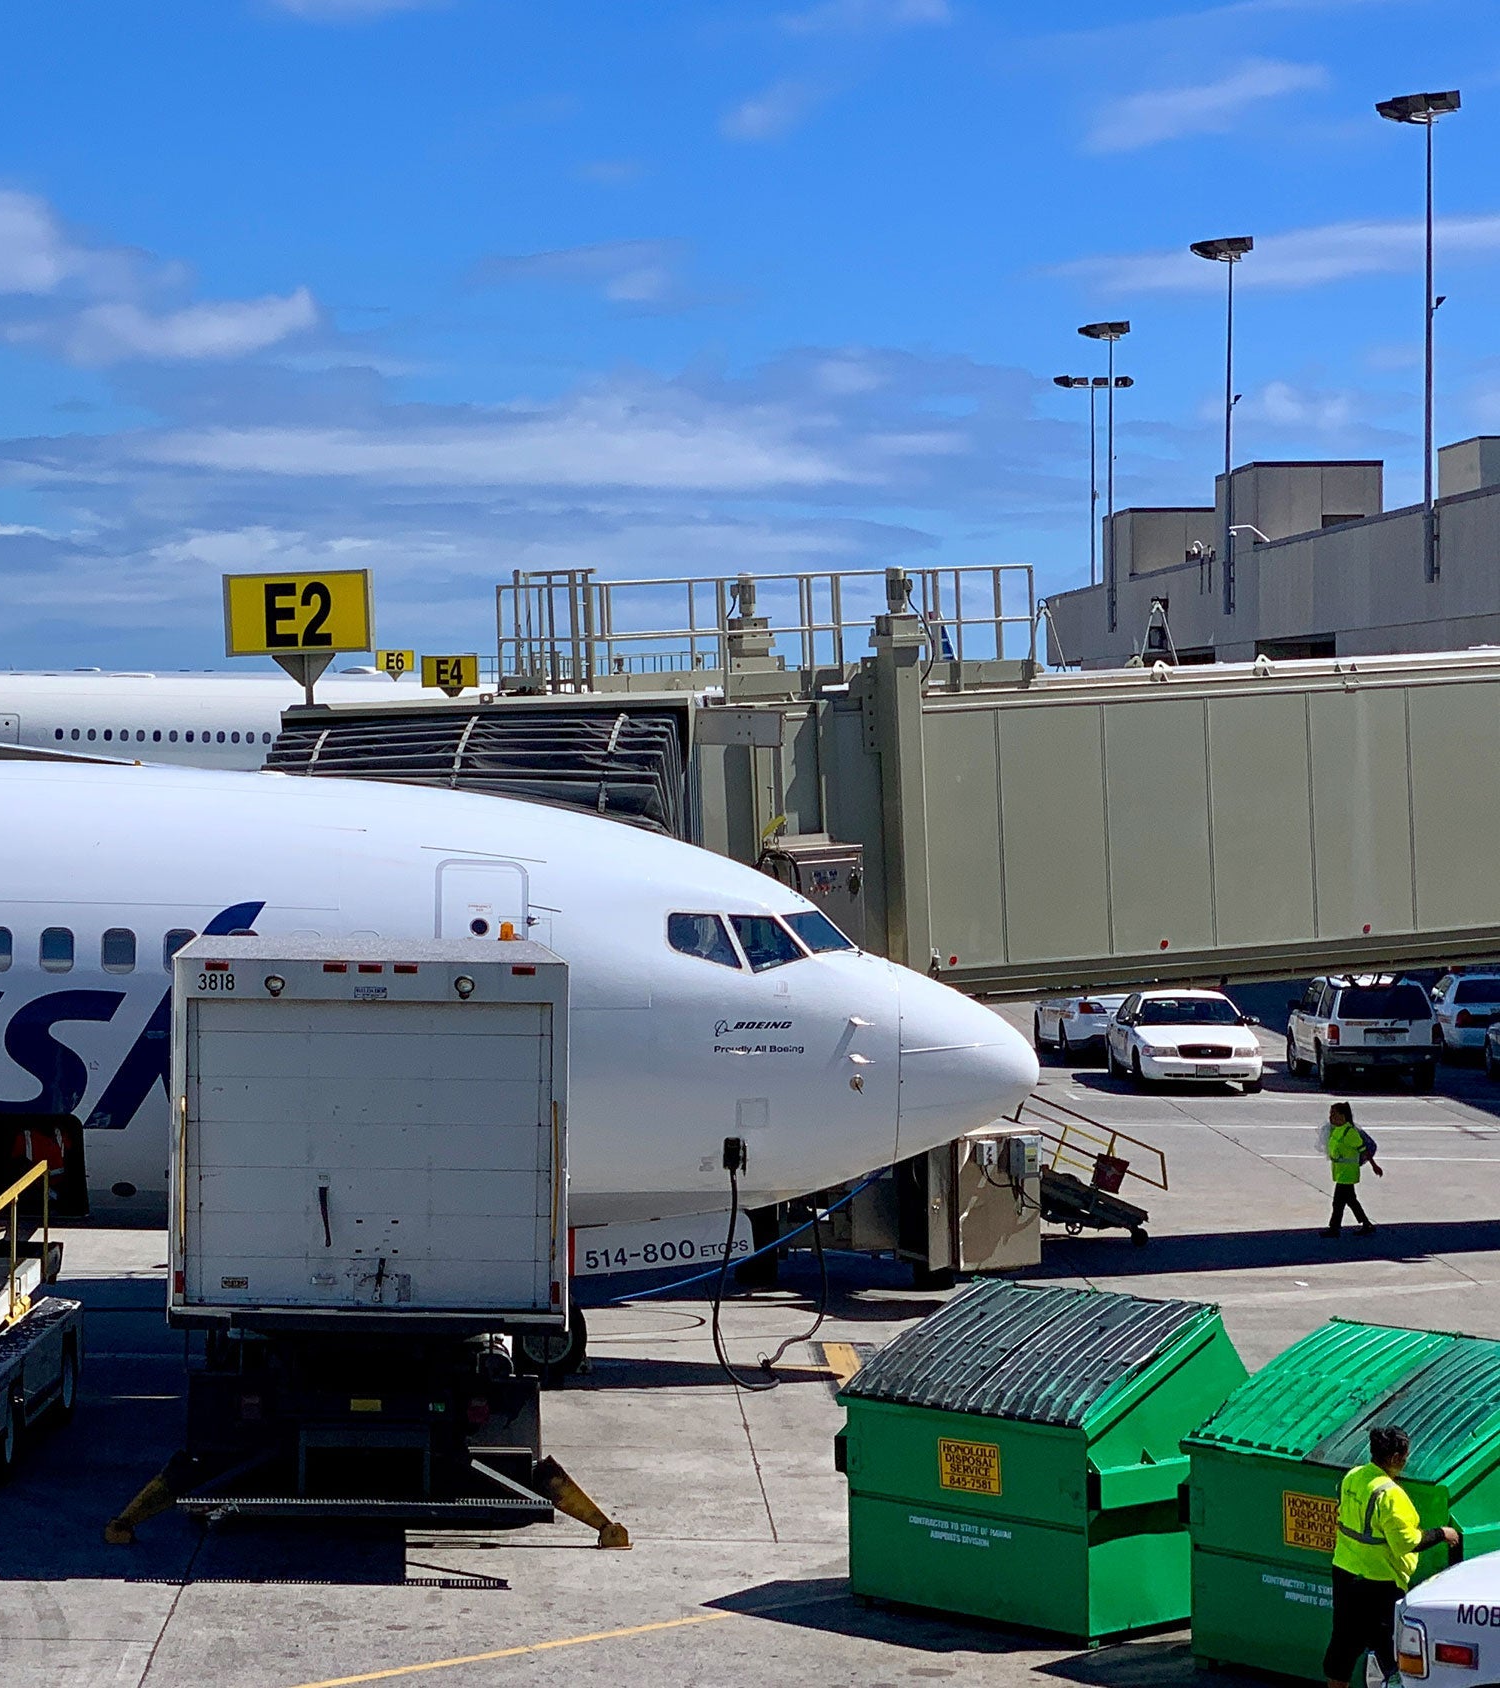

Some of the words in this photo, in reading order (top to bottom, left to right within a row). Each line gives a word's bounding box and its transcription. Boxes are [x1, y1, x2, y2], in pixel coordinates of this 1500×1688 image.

[264, 581, 332, 648] E2
[385, 652, 405, 672] E6
[435, 658, 464, 686] E4
[197, 973, 236, 992] 3818
[733, 1021, 793, 1030] BOEING
[713, 1044, 753, 1055] Proudly
[754, 1044, 767, 1053] All
[769, 1044, 805, 1054] Boeing
[585, 1239, 696, 1270] 514-800
[943, 1443, 996, 1458] HONOLULU
[945, 1453, 995, 1468] DISPOSAL
[950, 1463, 990, 1476] SERVICE
[908, 1515, 949, 1529] CONTRACTED
[950, 1521, 960, 1531] TO
[960, 1523, 980, 1534] STATE
[1294, 1518, 1336, 1534] SERVICE
